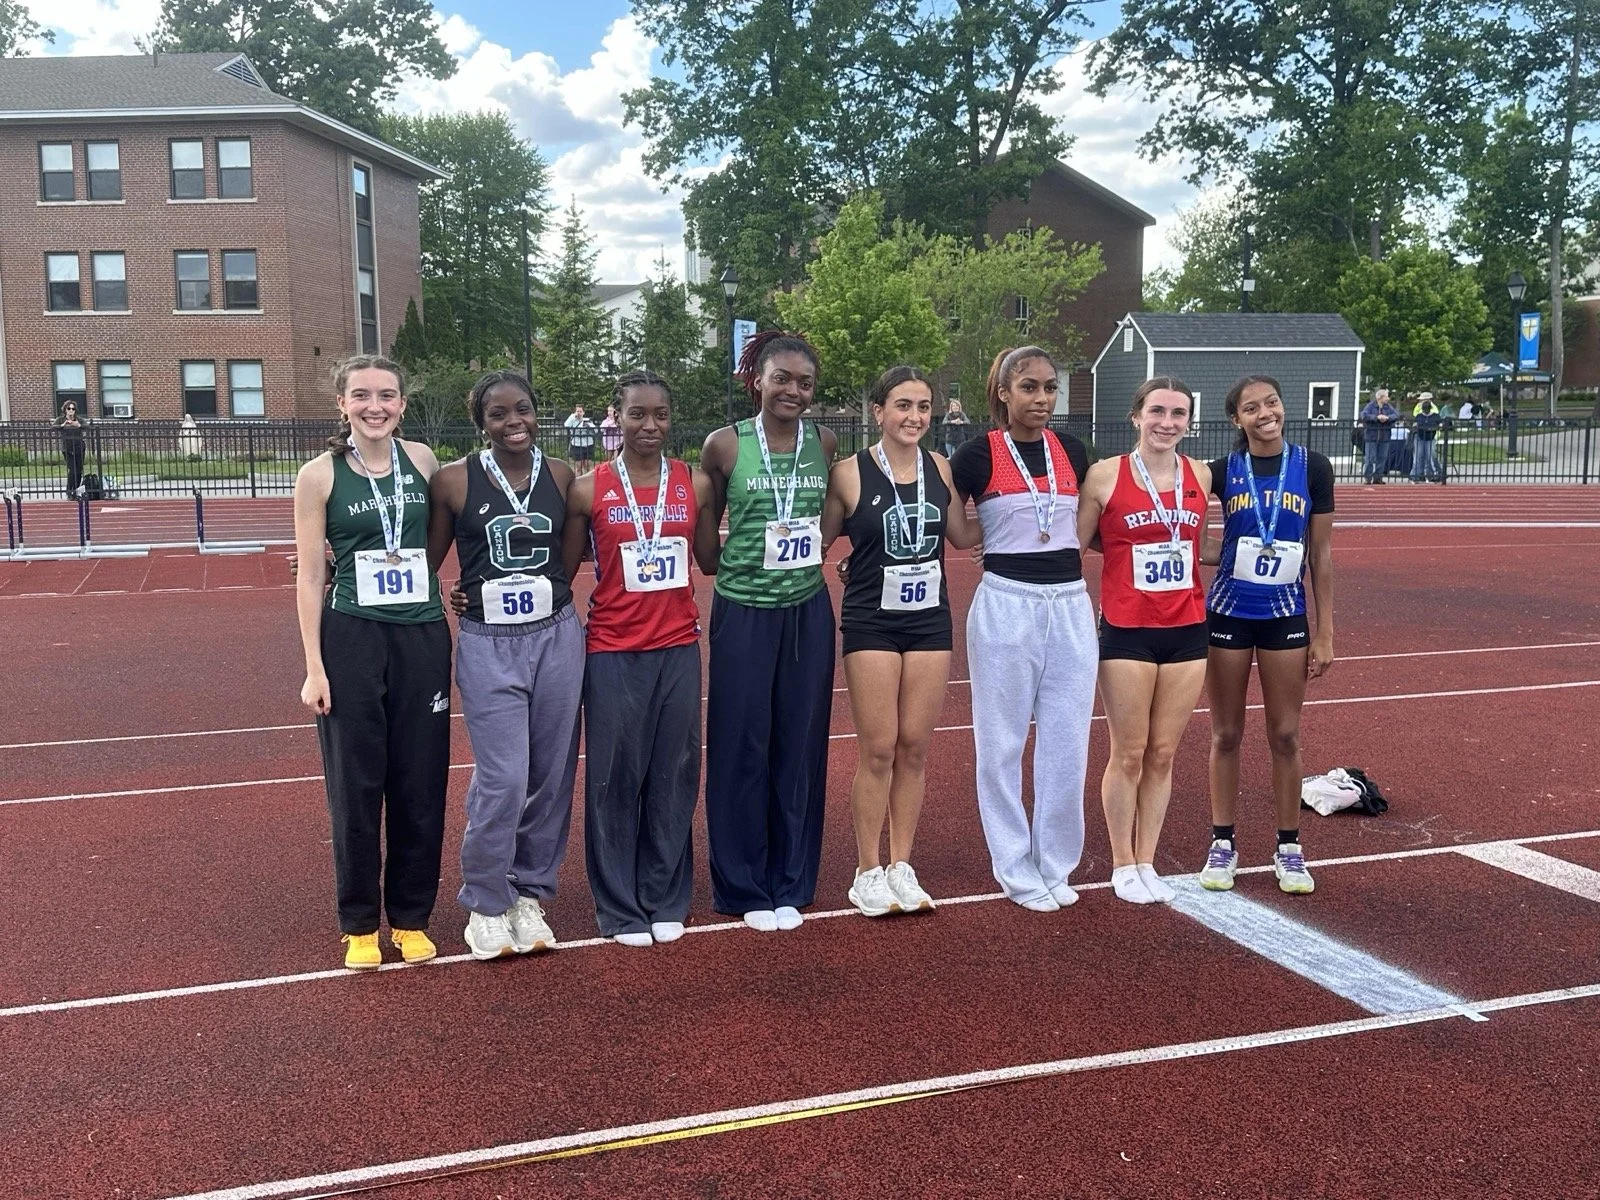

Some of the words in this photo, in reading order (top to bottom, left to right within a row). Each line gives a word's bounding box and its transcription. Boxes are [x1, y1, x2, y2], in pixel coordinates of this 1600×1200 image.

[675, 484, 688, 500] S
[746, 475, 824, 491] MINNECHAUG
[485, 512, 552, 572] C
[492, 524, 505, 563] CANTON
[889, 513, 899, 552] CANTON
[777, 535, 812, 562] 276
[636, 555, 676, 583] 397
[1144, 560, 1185, 584] 349
[1254, 555, 1282, 577] 67
[373, 569, 414, 595] 191
[900, 581, 927, 604] 56
[502, 591, 535, 616] 58
[1211, 632, 1233, 640] NIKE
[1287, 631, 1305, 640] PRO
